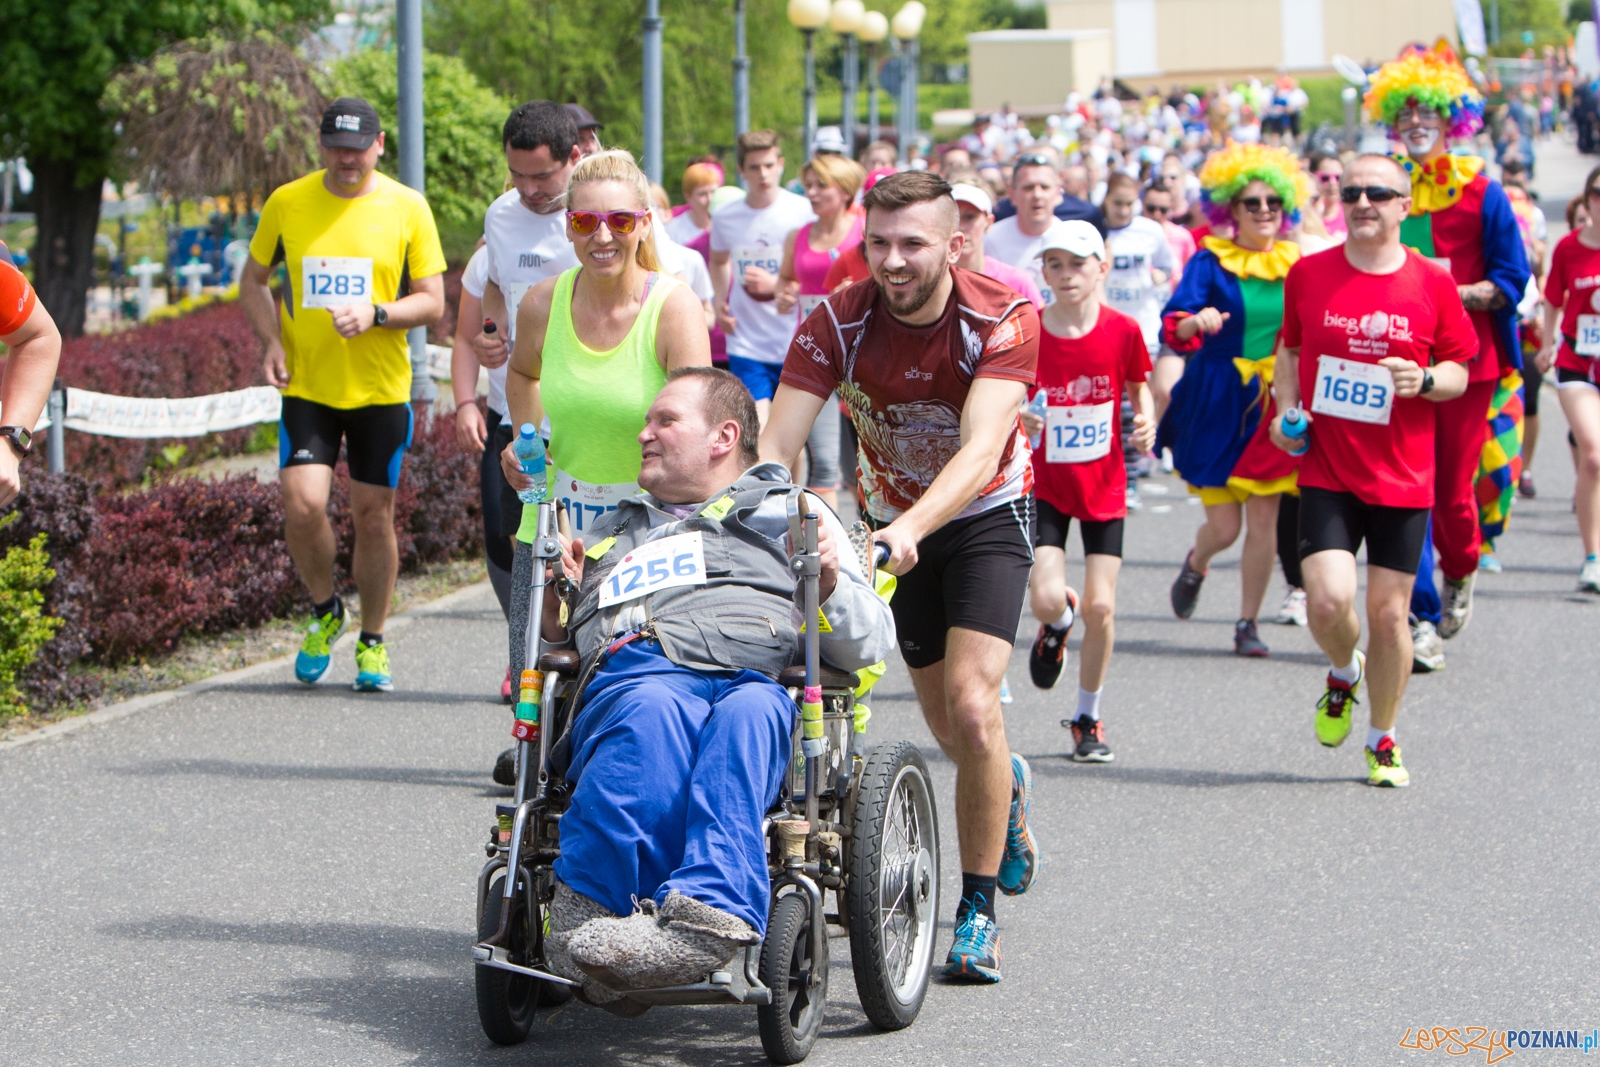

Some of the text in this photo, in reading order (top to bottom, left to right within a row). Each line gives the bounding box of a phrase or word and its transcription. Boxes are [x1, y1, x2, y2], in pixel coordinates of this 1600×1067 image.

[518, 254, 541, 268] RUN
[308, 273, 366, 296] 1283
[1323, 309, 1410, 336] bieg na
[1388, 324, 1414, 343] tak
[1323, 375, 1387, 409] 1683
[1053, 421, 1108, 448] 1295
[607, 553, 697, 598] 1256
